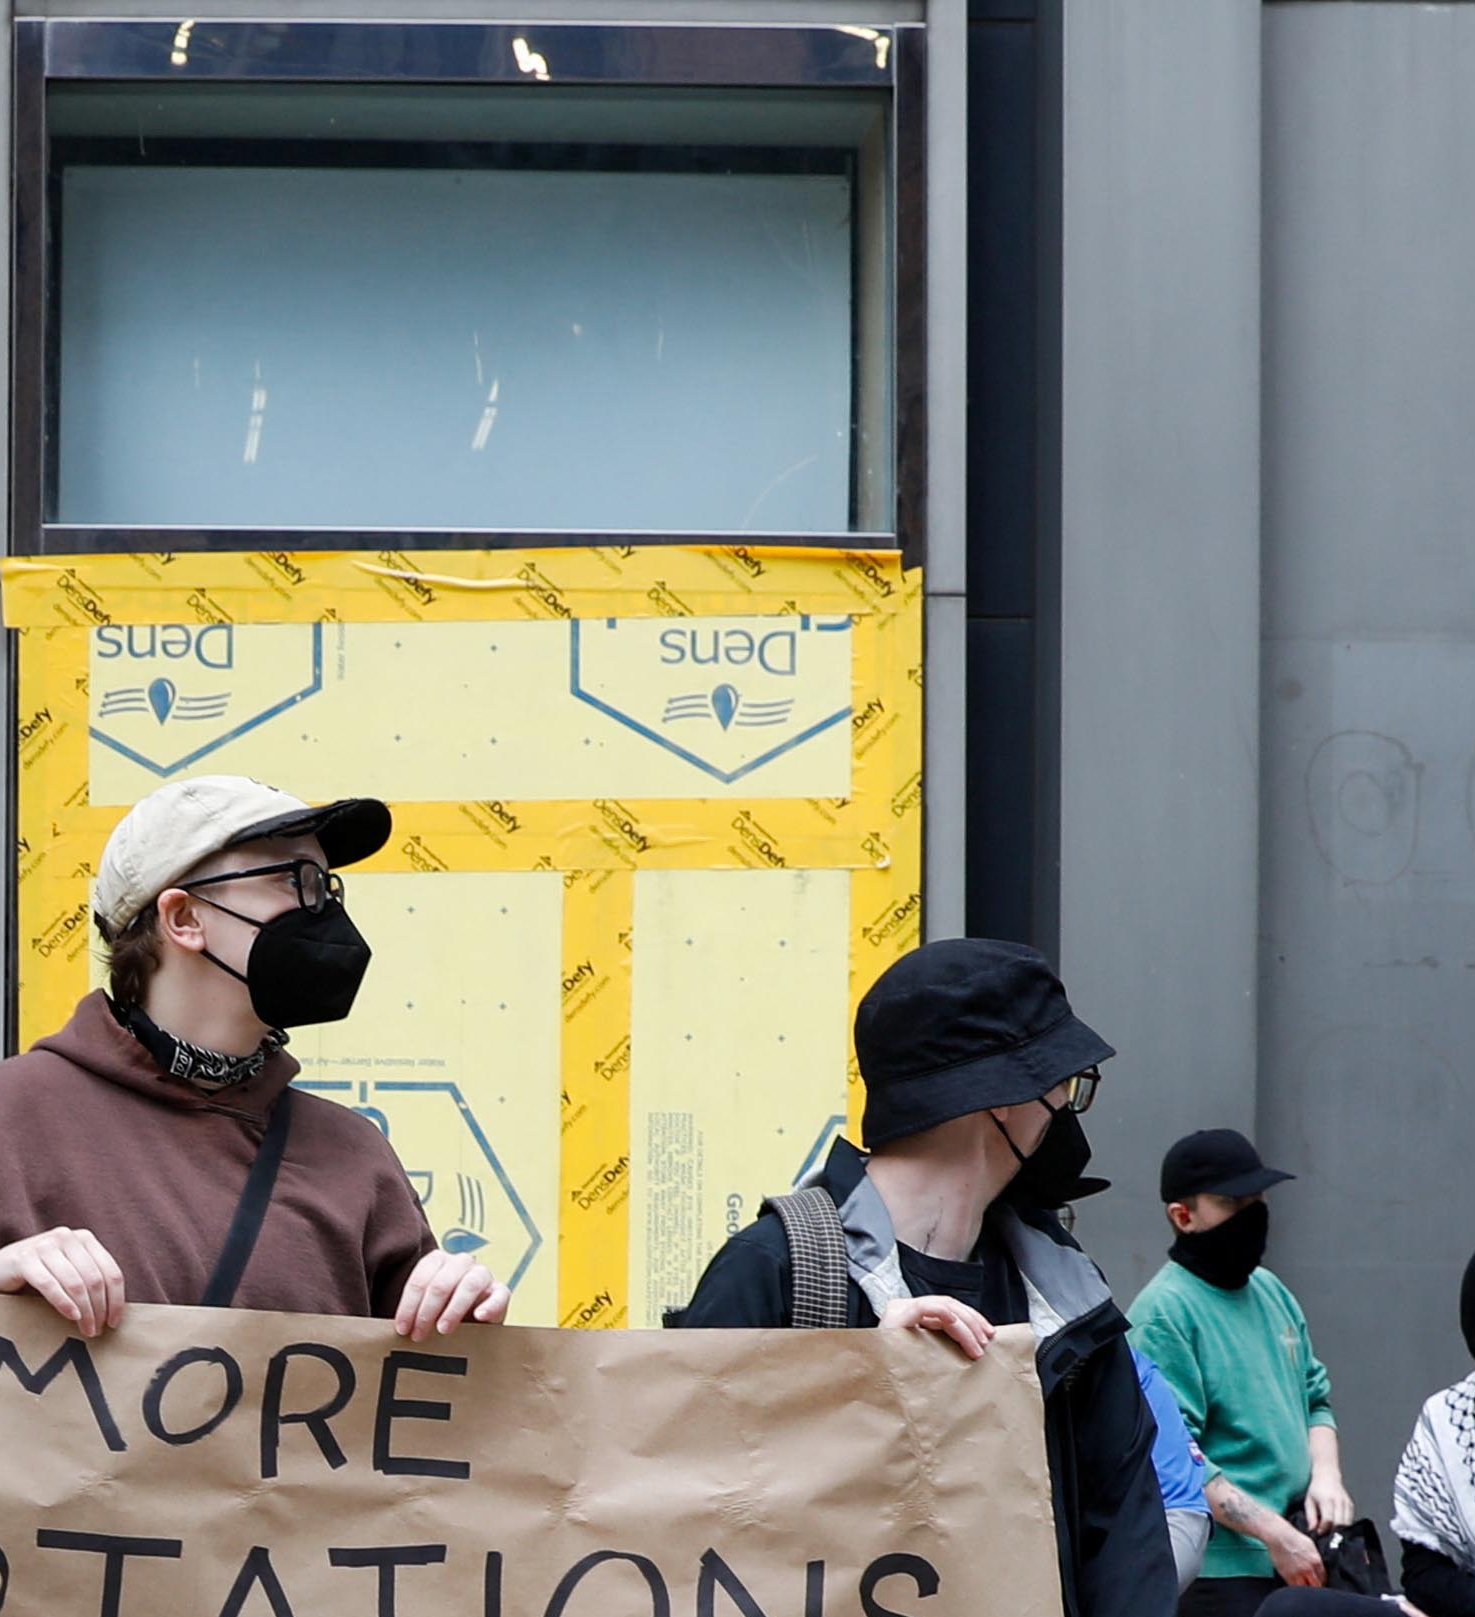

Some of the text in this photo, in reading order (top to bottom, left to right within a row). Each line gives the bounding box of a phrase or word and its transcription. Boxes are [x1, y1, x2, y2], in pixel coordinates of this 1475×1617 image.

[269, 552, 306, 586] Defy
[96, 624, 233, 669] Dens
[659, 629, 796, 675] Dens
